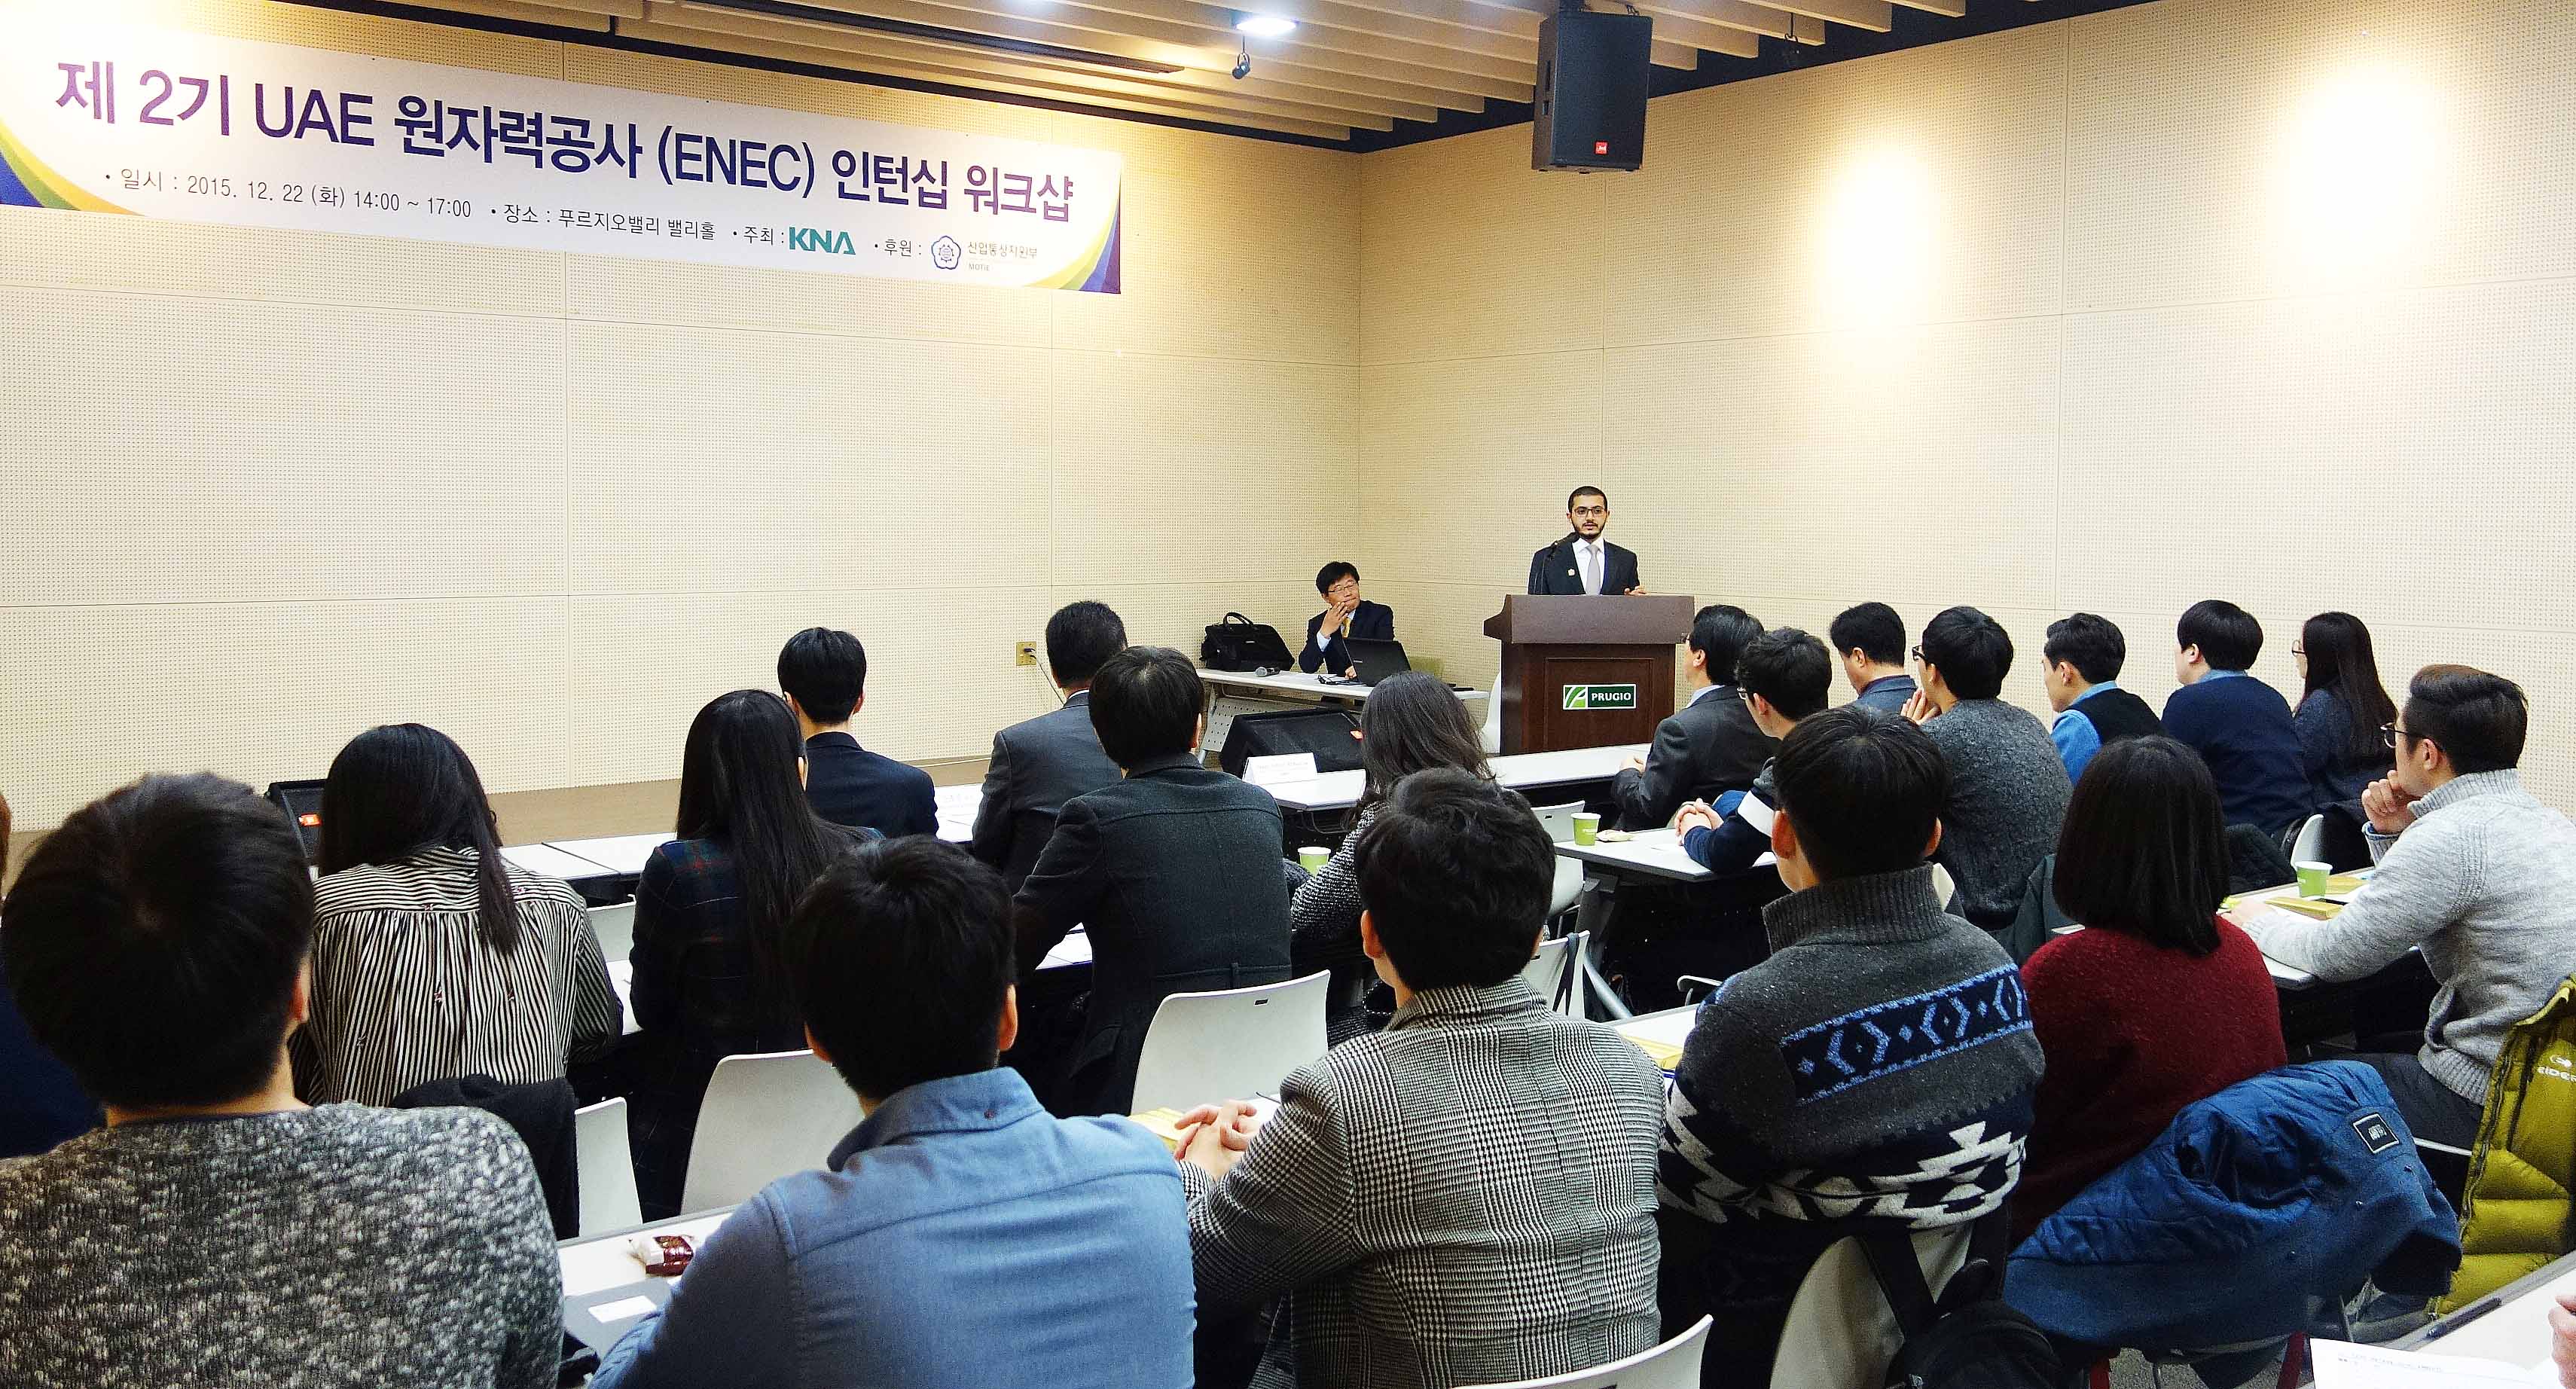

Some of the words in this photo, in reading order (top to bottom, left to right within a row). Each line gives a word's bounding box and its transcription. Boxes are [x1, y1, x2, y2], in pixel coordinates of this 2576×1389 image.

[56, 62, 114, 124] 제
[140, 69, 229, 136] 2기
[255, 83, 375, 147] UAE
[395, 94, 643, 179] 원자력공사
[658, 124, 815, 199] (ENEC)
[832, 151, 948, 209] 인턴십
[964, 165, 1073, 222] 워크샵
[188, 176, 237, 197] 2015.
[248, 182, 273, 200] 12.
[283, 185, 304, 202] 22
[312, 185, 344, 208] (화)
[354, 191, 399, 211] 14:00
[428, 197, 471, 217] 17:00
[558, 209, 658, 235] 푸르지오밸리
[668, 219, 716, 240] 밸리홀
[789, 227, 856, 255] KNA
[1591, 692, 1631, 701] PRUGIO
